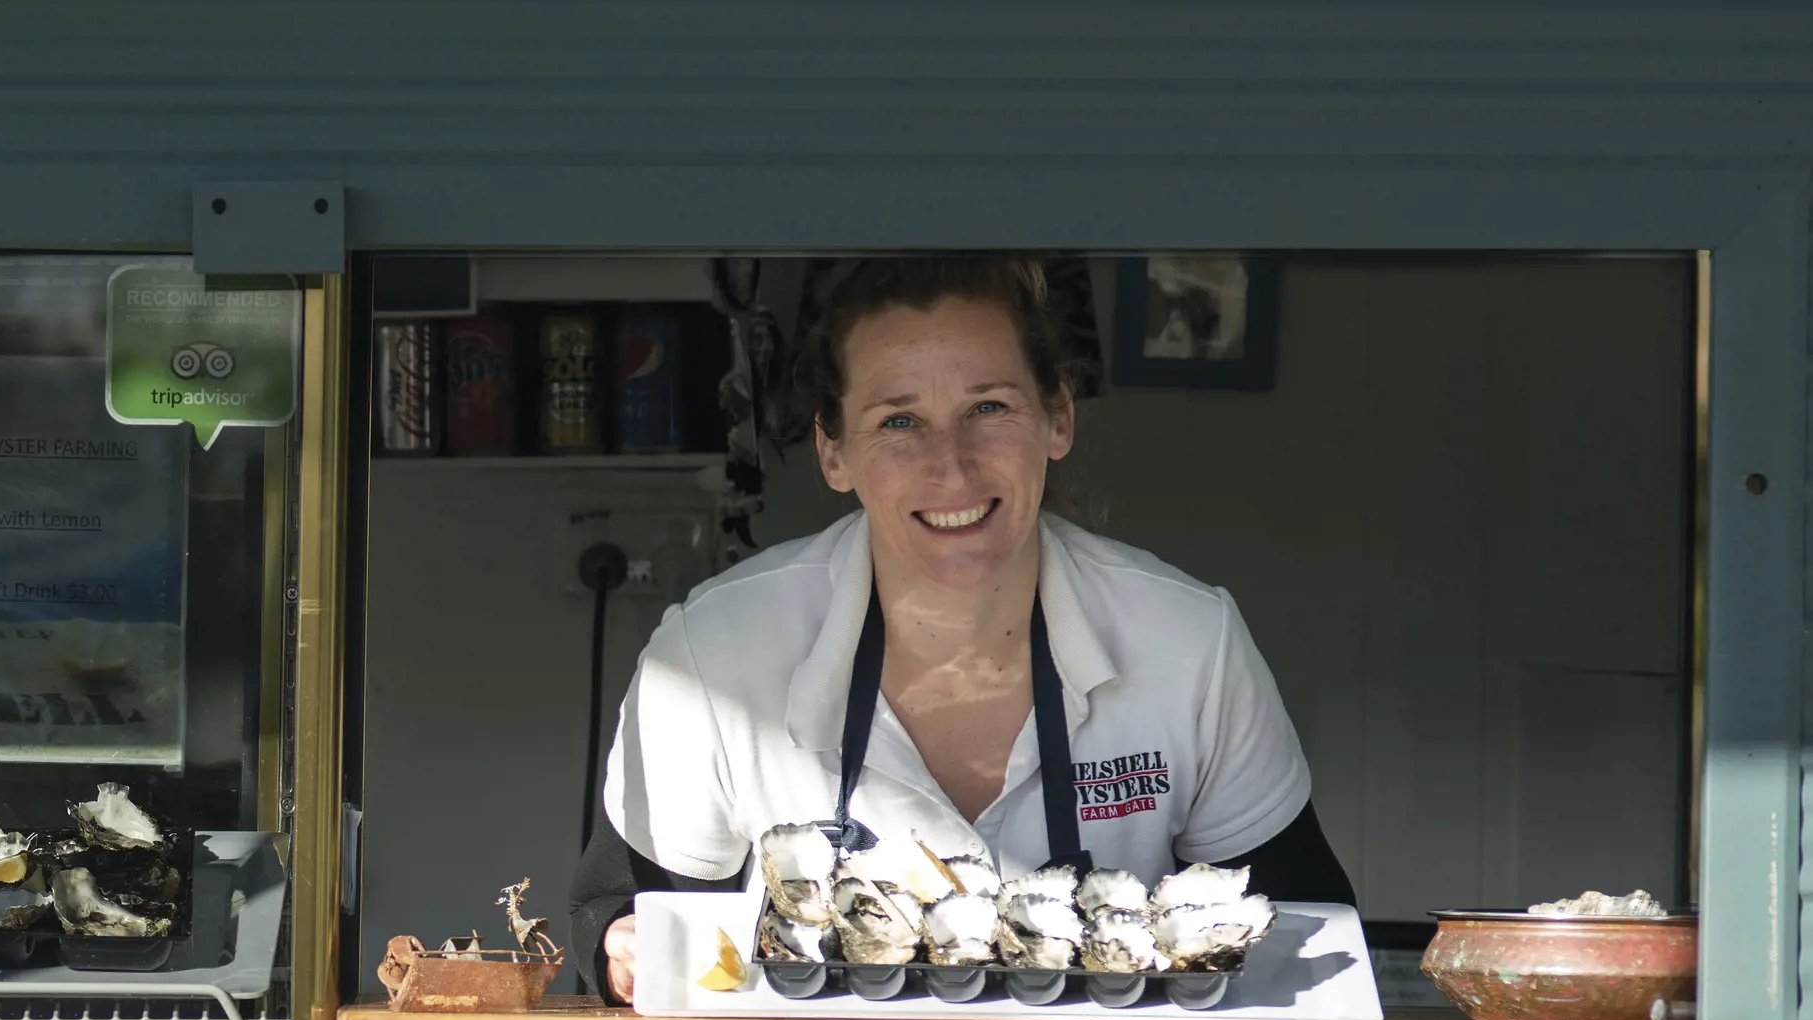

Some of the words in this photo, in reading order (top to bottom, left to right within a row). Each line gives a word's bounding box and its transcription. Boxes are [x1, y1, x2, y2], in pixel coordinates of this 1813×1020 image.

[127, 290, 280, 307] RECOMMENDED
[150, 387, 247, 409] tripadvisor
[54, 439, 138, 458] FARMING
[41, 510, 101, 529] Lemon
[15, 582, 61, 601] Drink
[67, 584, 118, 601] $3.00
[1073, 751, 1167, 781] ELSHELL
[1077, 773, 1171, 805] YSTERS
[1082, 806, 1119, 820] FARM
[1125, 798, 1155, 812] GATE
